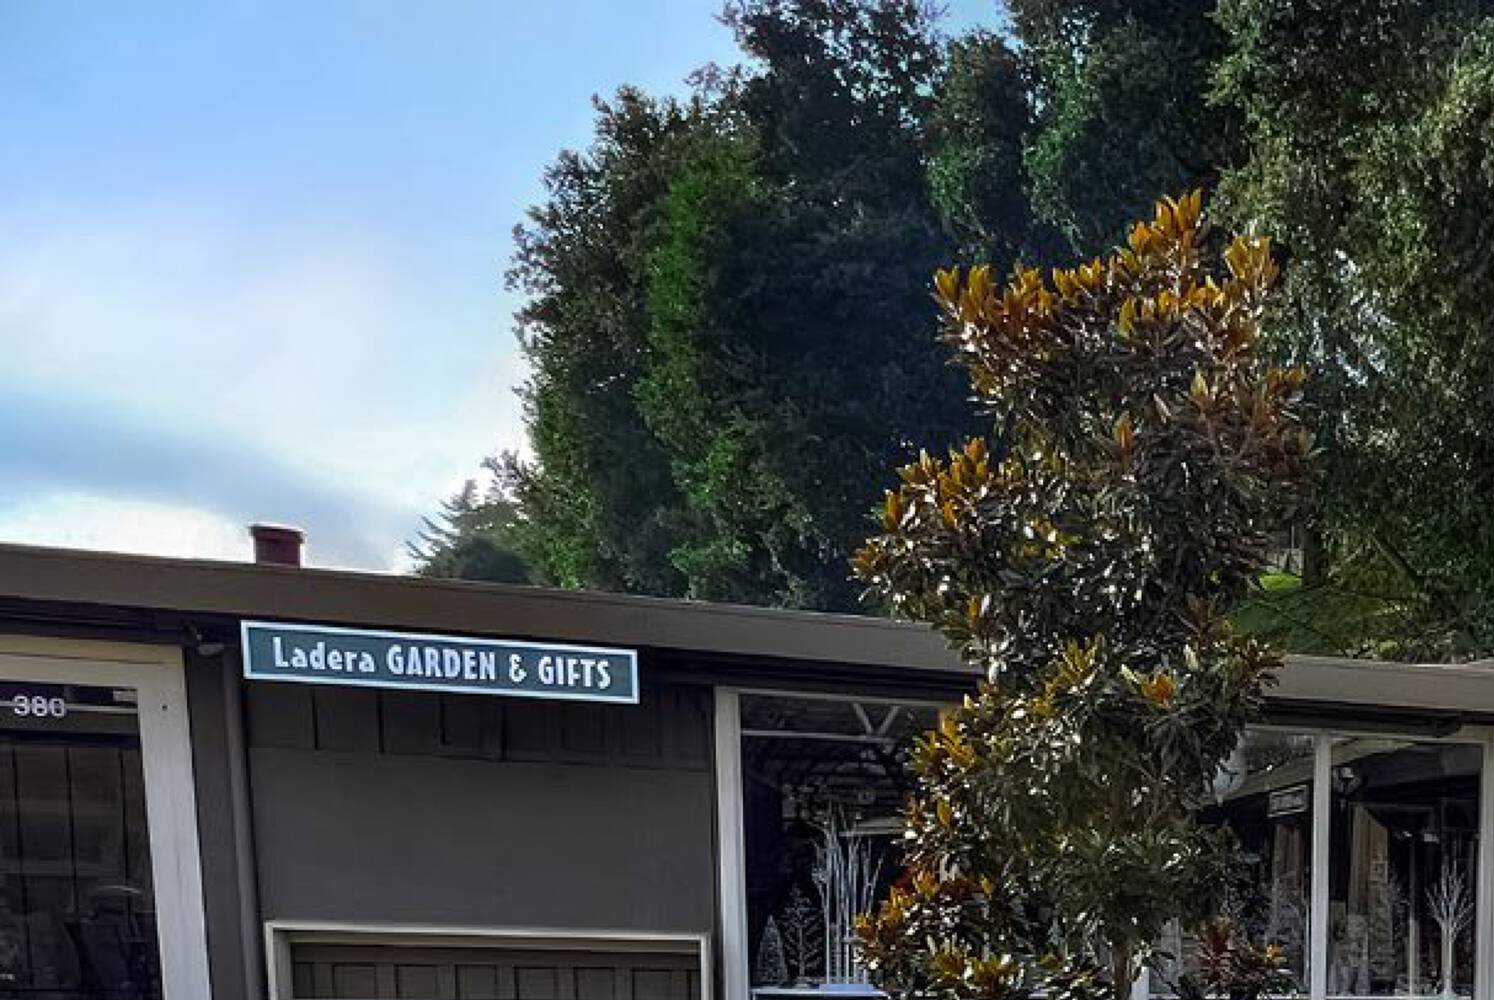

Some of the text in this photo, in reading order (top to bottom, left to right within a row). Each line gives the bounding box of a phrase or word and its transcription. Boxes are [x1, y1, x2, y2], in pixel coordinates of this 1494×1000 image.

[272, 636, 612, 690] Ladera GARDEN & GIFTS
[13, 695, 65, 717] 380
